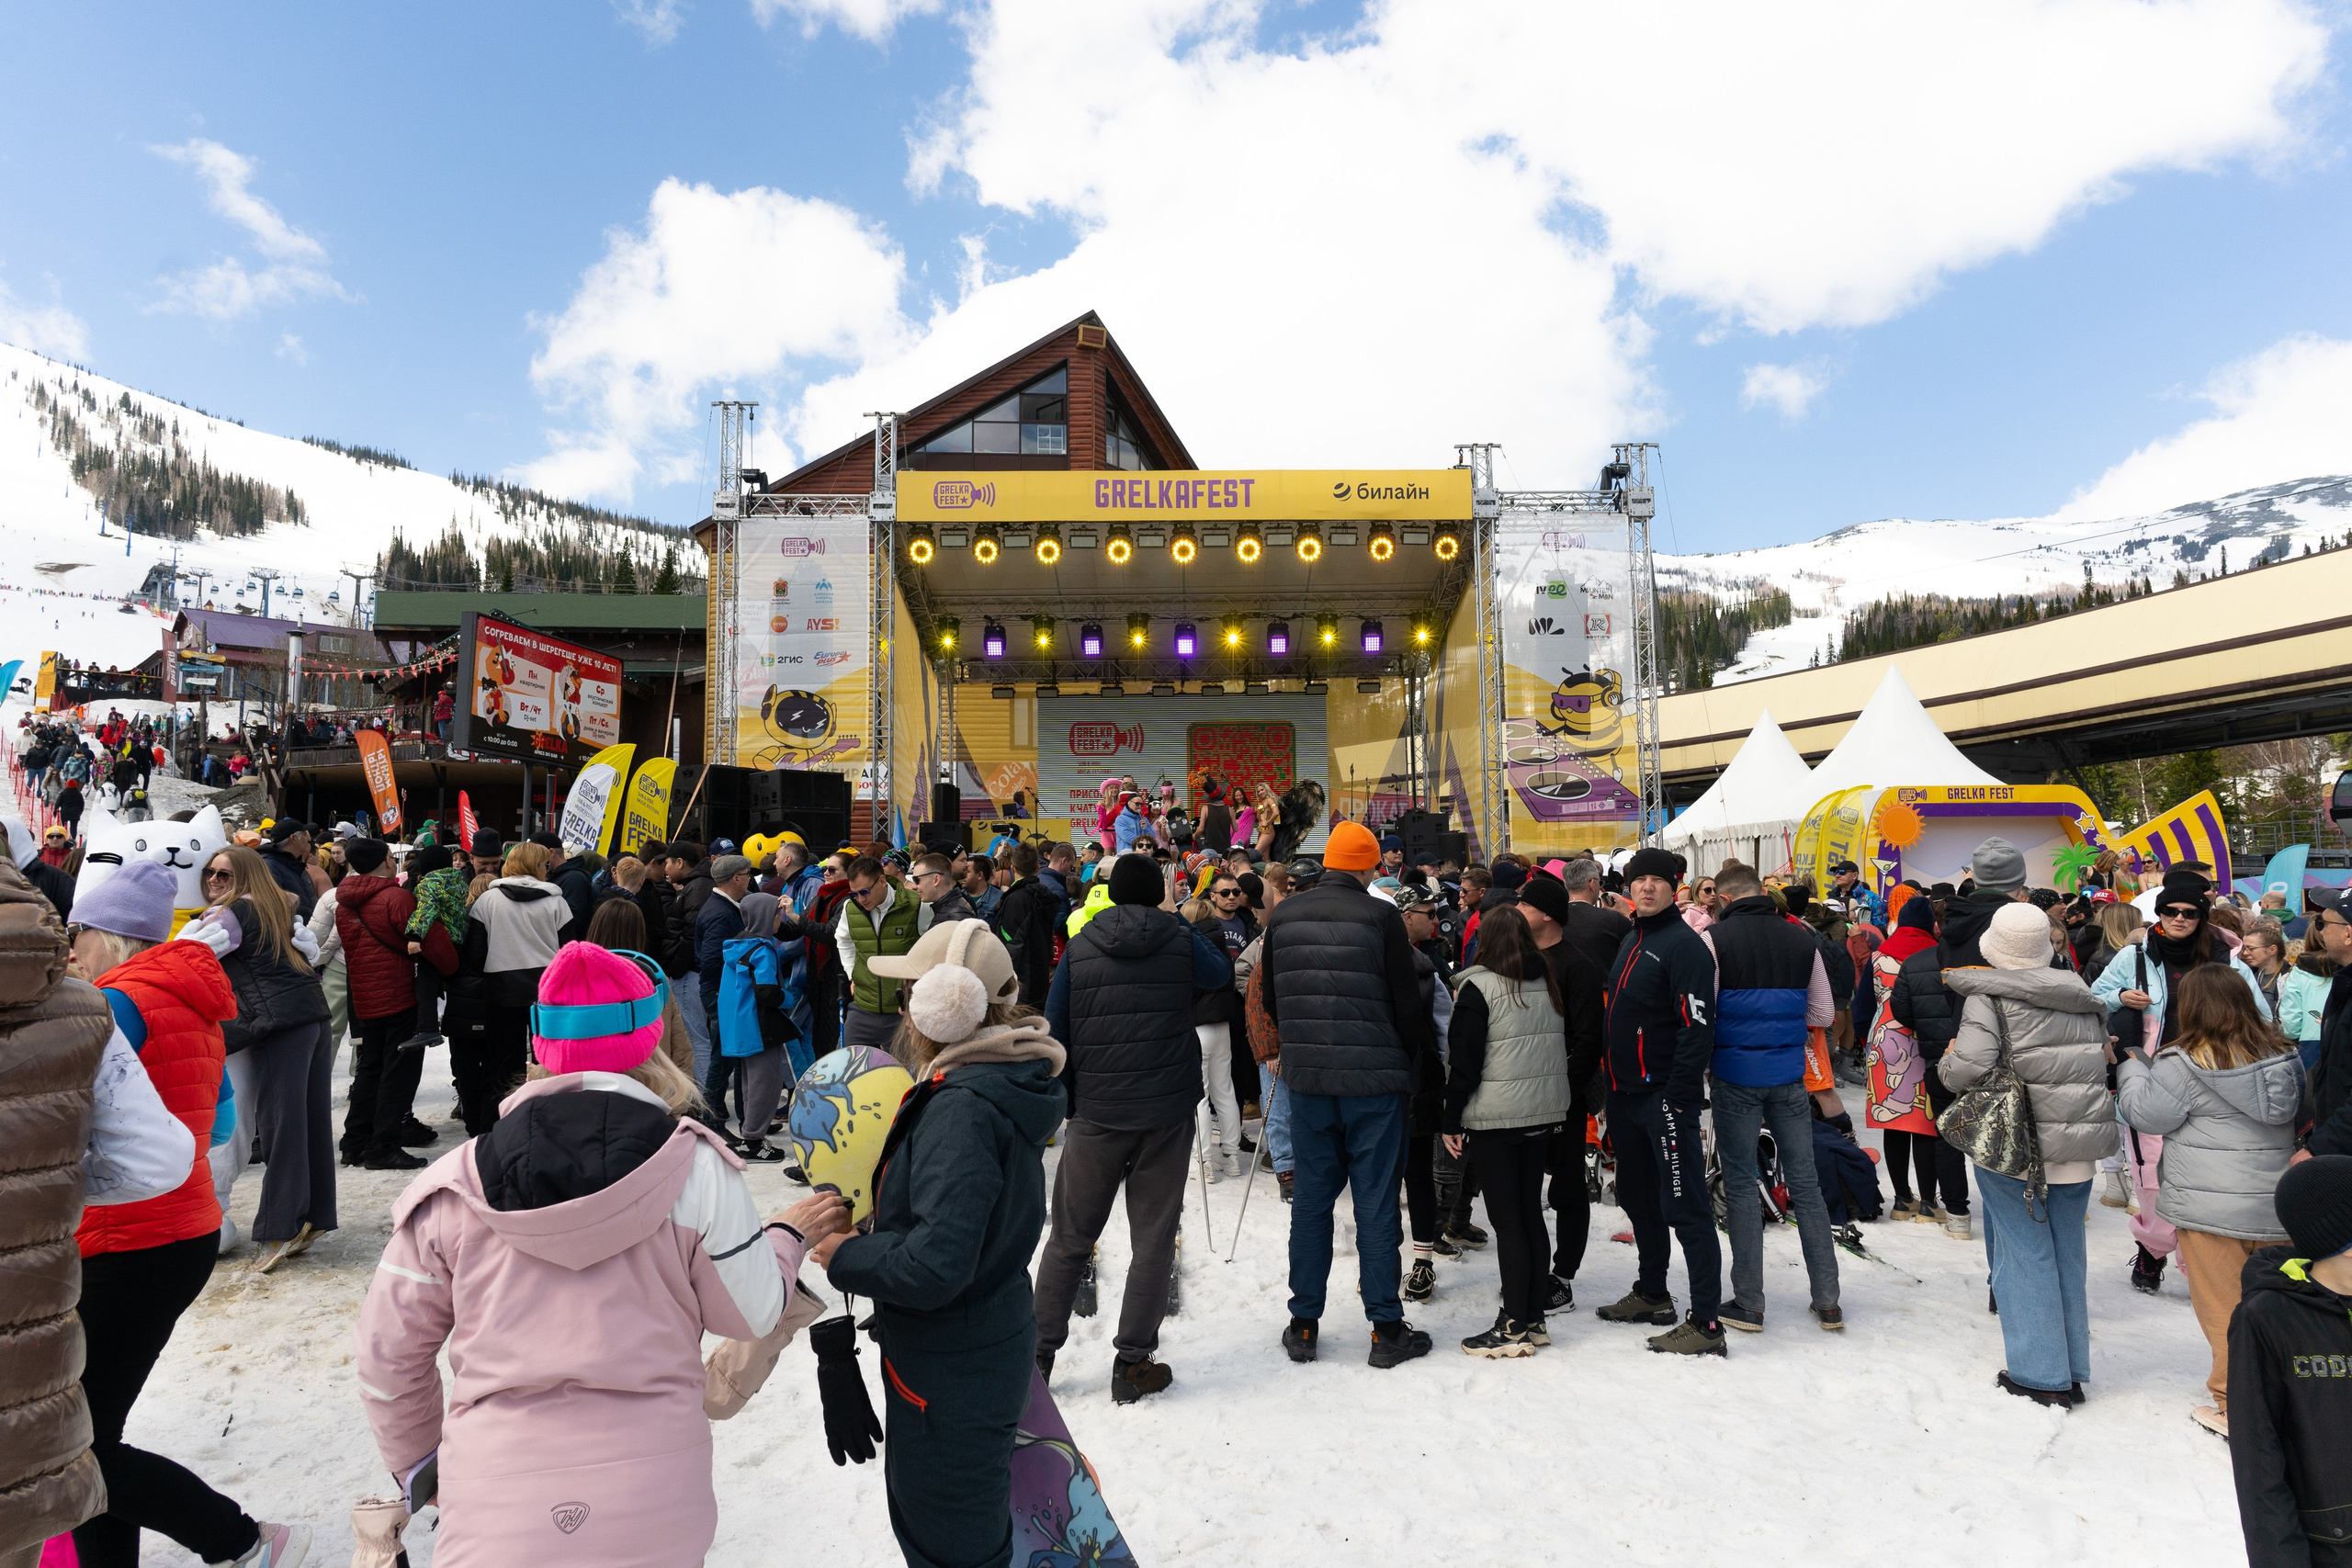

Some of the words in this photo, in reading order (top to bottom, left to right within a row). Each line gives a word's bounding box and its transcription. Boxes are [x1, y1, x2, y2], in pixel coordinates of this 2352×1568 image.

[940, 485, 969, 494] GRELKA
[1095, 479, 1255, 509] GRELKAFEST
[1356, 482, 1430, 501] билайн
[940, 496, 959, 504] FEST
[484, 626, 531, 648] СОГРЕВАЕМ
[532, 640, 537, 649] В
[538, 642, 577, 661] ШЕРЕГЕШЕ
[577, 654, 593, 666] УЖЕ
[594, 660, 601, 668] 10
[602, 662, 616, 673] ЛЕТ!
[777, 656, 803, 664] 2ГИС
[1077, 727, 1113, 738] GRELKA
[487, 736, 500, 744] 10:00
[507, 739, 518, 748] 0:00
[534, 734, 568, 754] GRELKA
[1077, 739, 1101, 750] FEST
[640, 782, 650, 792] FEST
[642, 775, 655, 789] GRELKA
[1947, 787, 1985, 800] GRELKA
[1989, 787, 2015, 799] FEST
[1339, 796, 1408, 821] ПРОКАТ
[628, 811, 663, 841] GRELKA
[1671, 1152, 1681, 1198] HILFIGER
